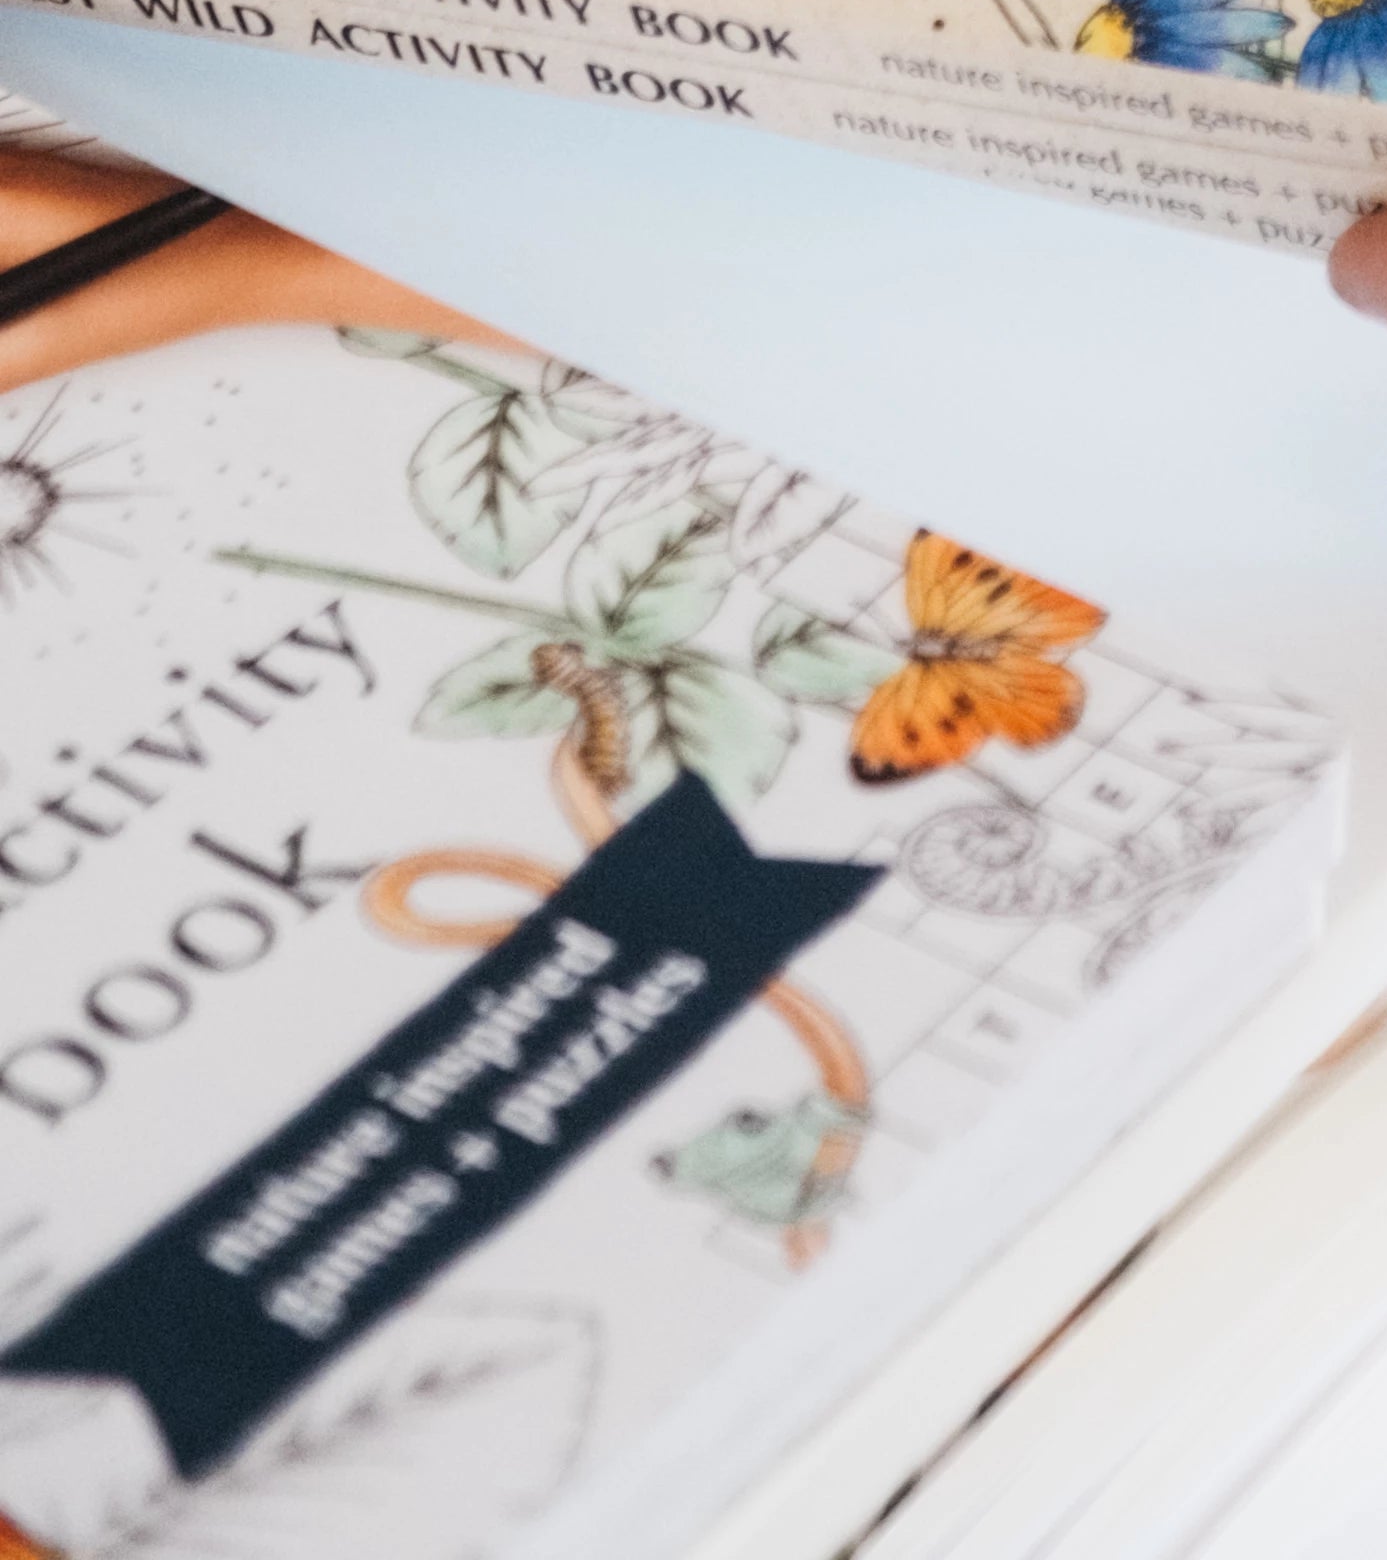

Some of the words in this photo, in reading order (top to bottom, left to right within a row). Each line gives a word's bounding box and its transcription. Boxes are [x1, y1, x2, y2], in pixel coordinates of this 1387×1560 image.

[309, 18, 548, 85] ACTIVITY
[584, 62, 757, 120] BOOK
[832, 109, 953, 148] nature
[966, 129, 1124, 176] inspired
[1136, 158, 1261, 198] games
[630, 4, 800, 62] BOOK
[880, 53, 1002, 92] nature
[1016, 72, 1175, 120] inspired
[1188, 104, 1313, 144] games
[0, 600, 377, 912] ctivity
[206, 1106, 400, 1275] nature
[370, 916, 618, 1119] inspired
[262, 1166, 460, 1340] games
[494, 949, 709, 1147] puzzles
